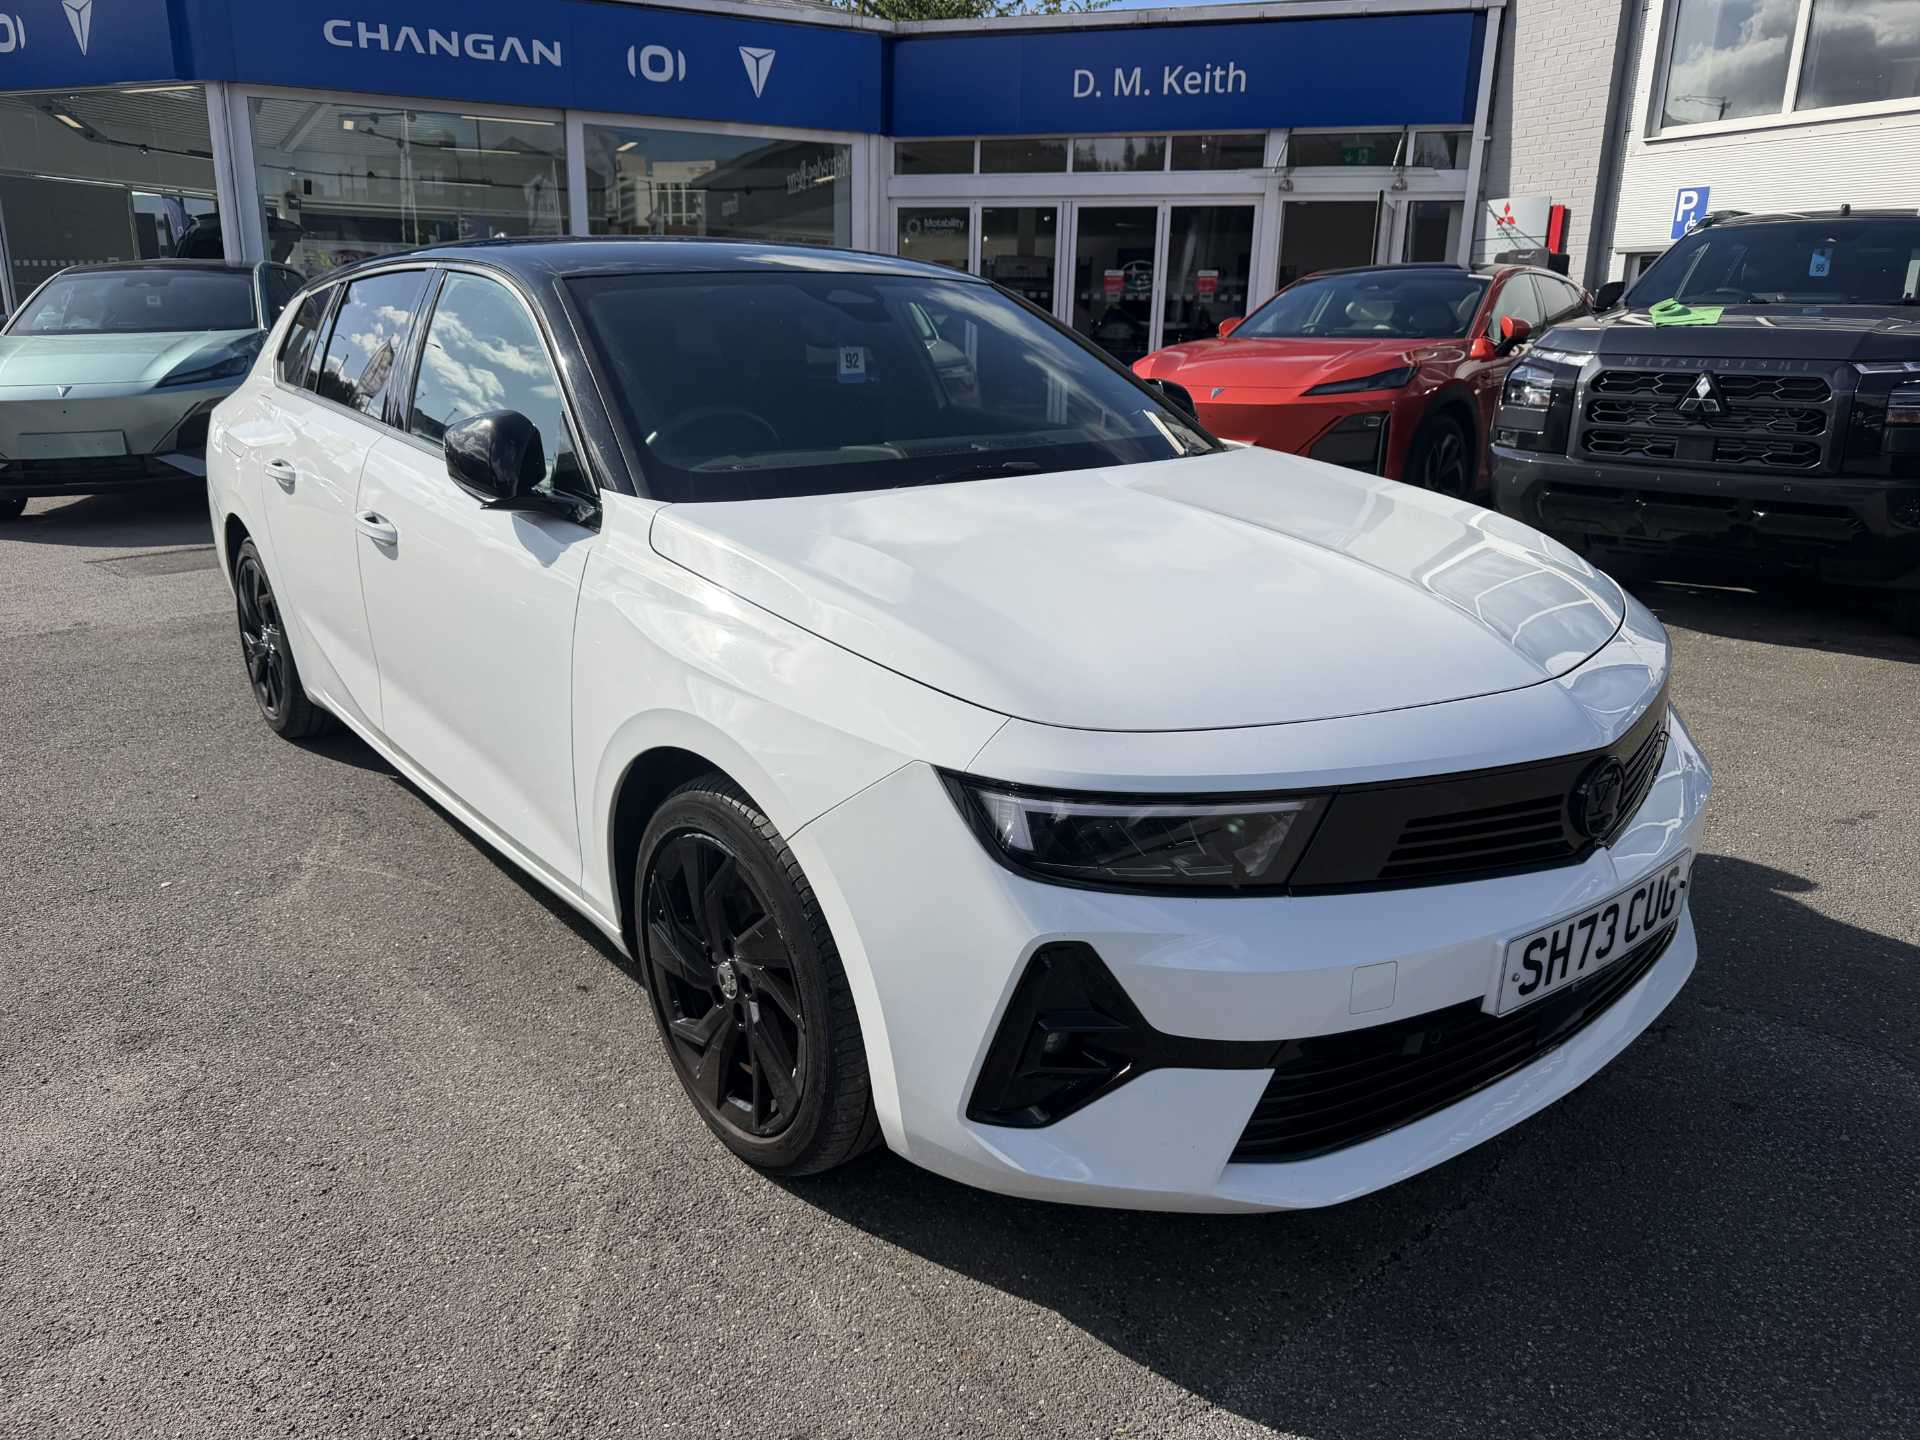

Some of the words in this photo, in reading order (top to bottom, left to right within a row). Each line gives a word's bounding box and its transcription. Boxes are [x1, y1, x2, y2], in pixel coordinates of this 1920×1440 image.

[323, 19, 562, 66] CHANGAN
[1073, 69, 1101, 98] D.
[1113, 67, 1150, 97] M.
[1163, 62, 1246, 94] Keith
[1677, 190, 1699, 222] P
[845, 352, 860, 369] 92
[1518, 902, 1620, 996] SH73
[1624, 866, 1680, 943] CUG
